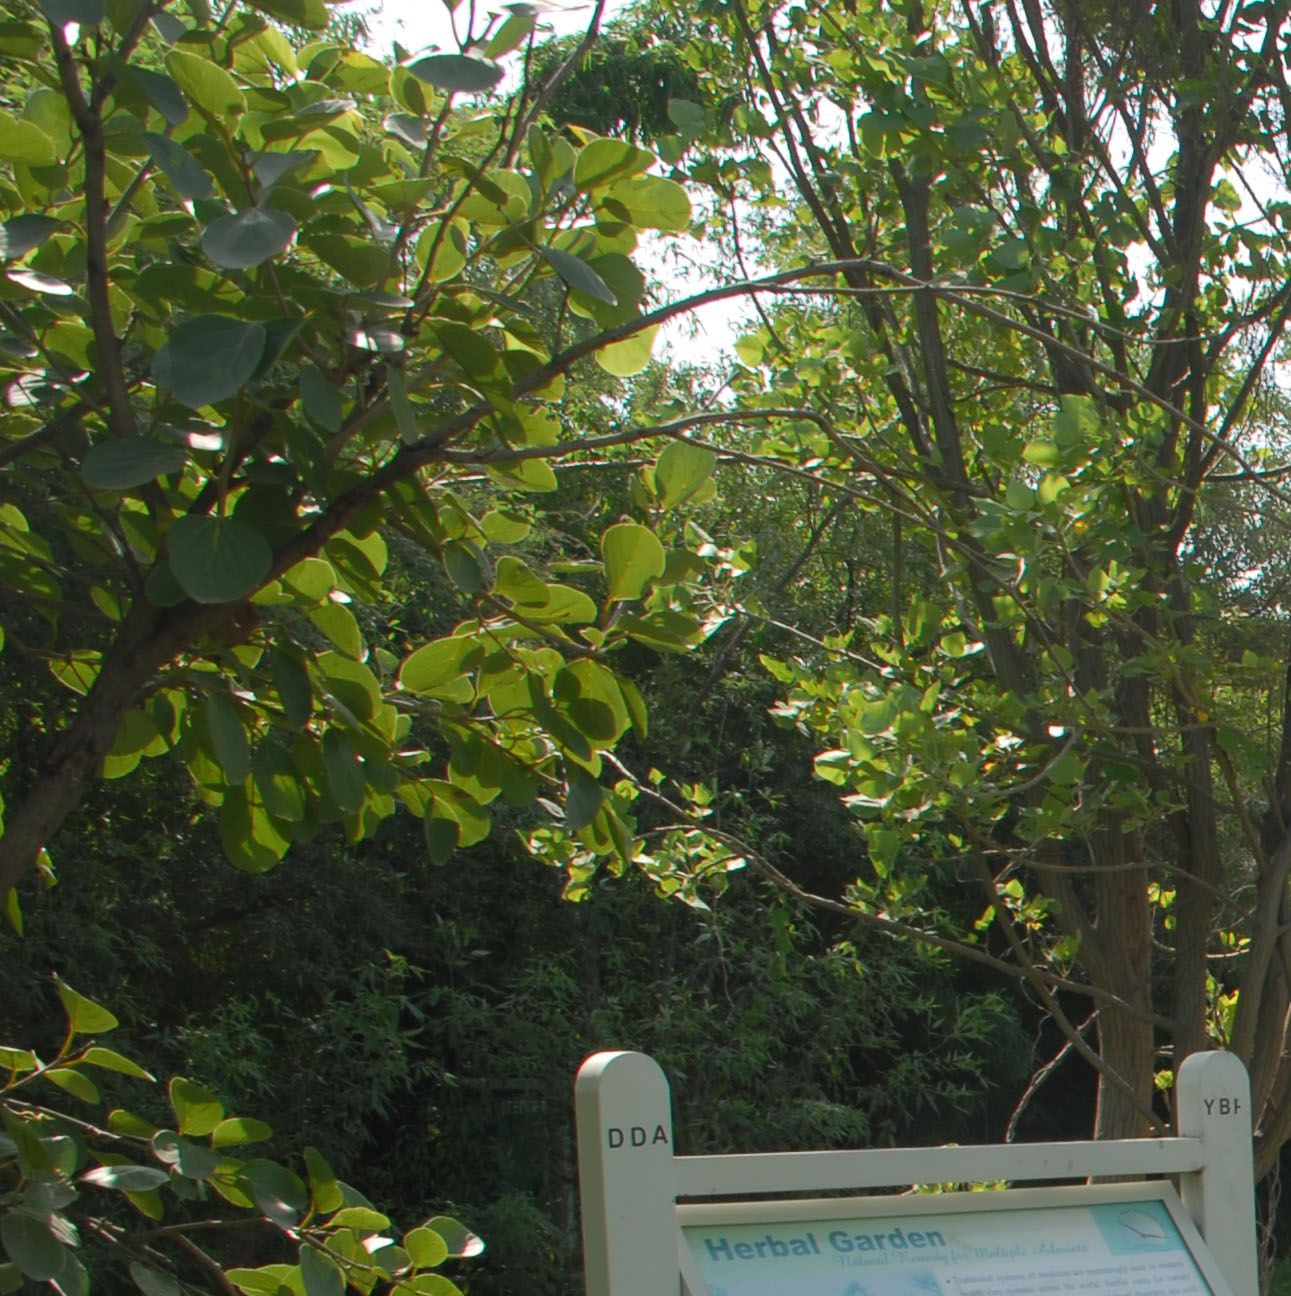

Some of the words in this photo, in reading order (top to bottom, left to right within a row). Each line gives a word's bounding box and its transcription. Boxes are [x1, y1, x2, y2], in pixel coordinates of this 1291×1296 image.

[608, 1125, 668, 1149] DDA
[704, 1232, 822, 1262] Herbal
[828, 1227, 946, 1254] Garden
